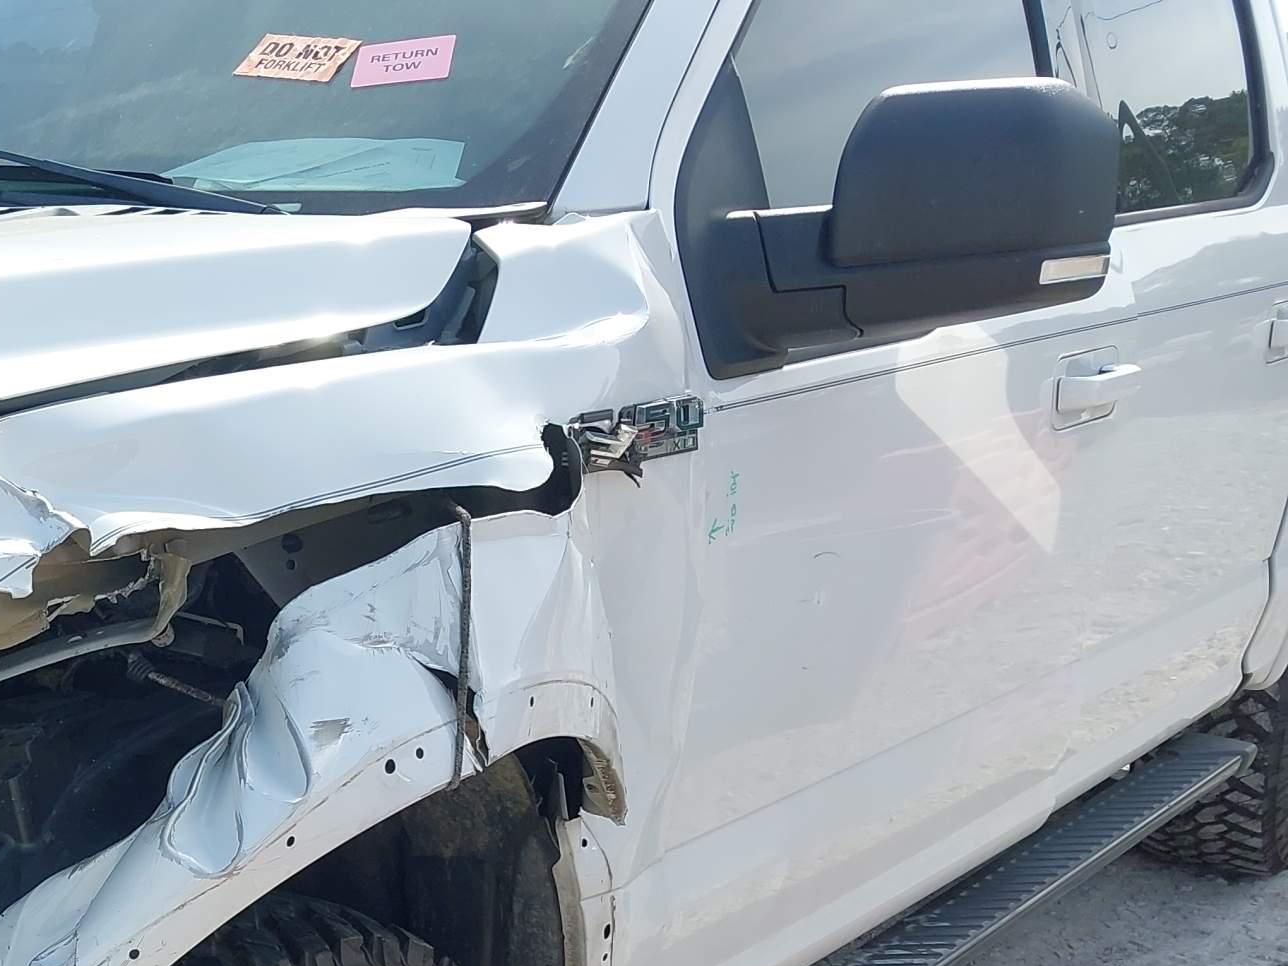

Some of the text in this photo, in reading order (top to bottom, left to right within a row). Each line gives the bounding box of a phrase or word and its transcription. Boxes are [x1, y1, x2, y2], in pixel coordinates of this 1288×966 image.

[259, 41, 347, 62] DO NOT
[370, 47, 439, 64] RETURN
[254, 58, 326, 73] FORKLIFT
[383, 60, 423, 73] TOW
